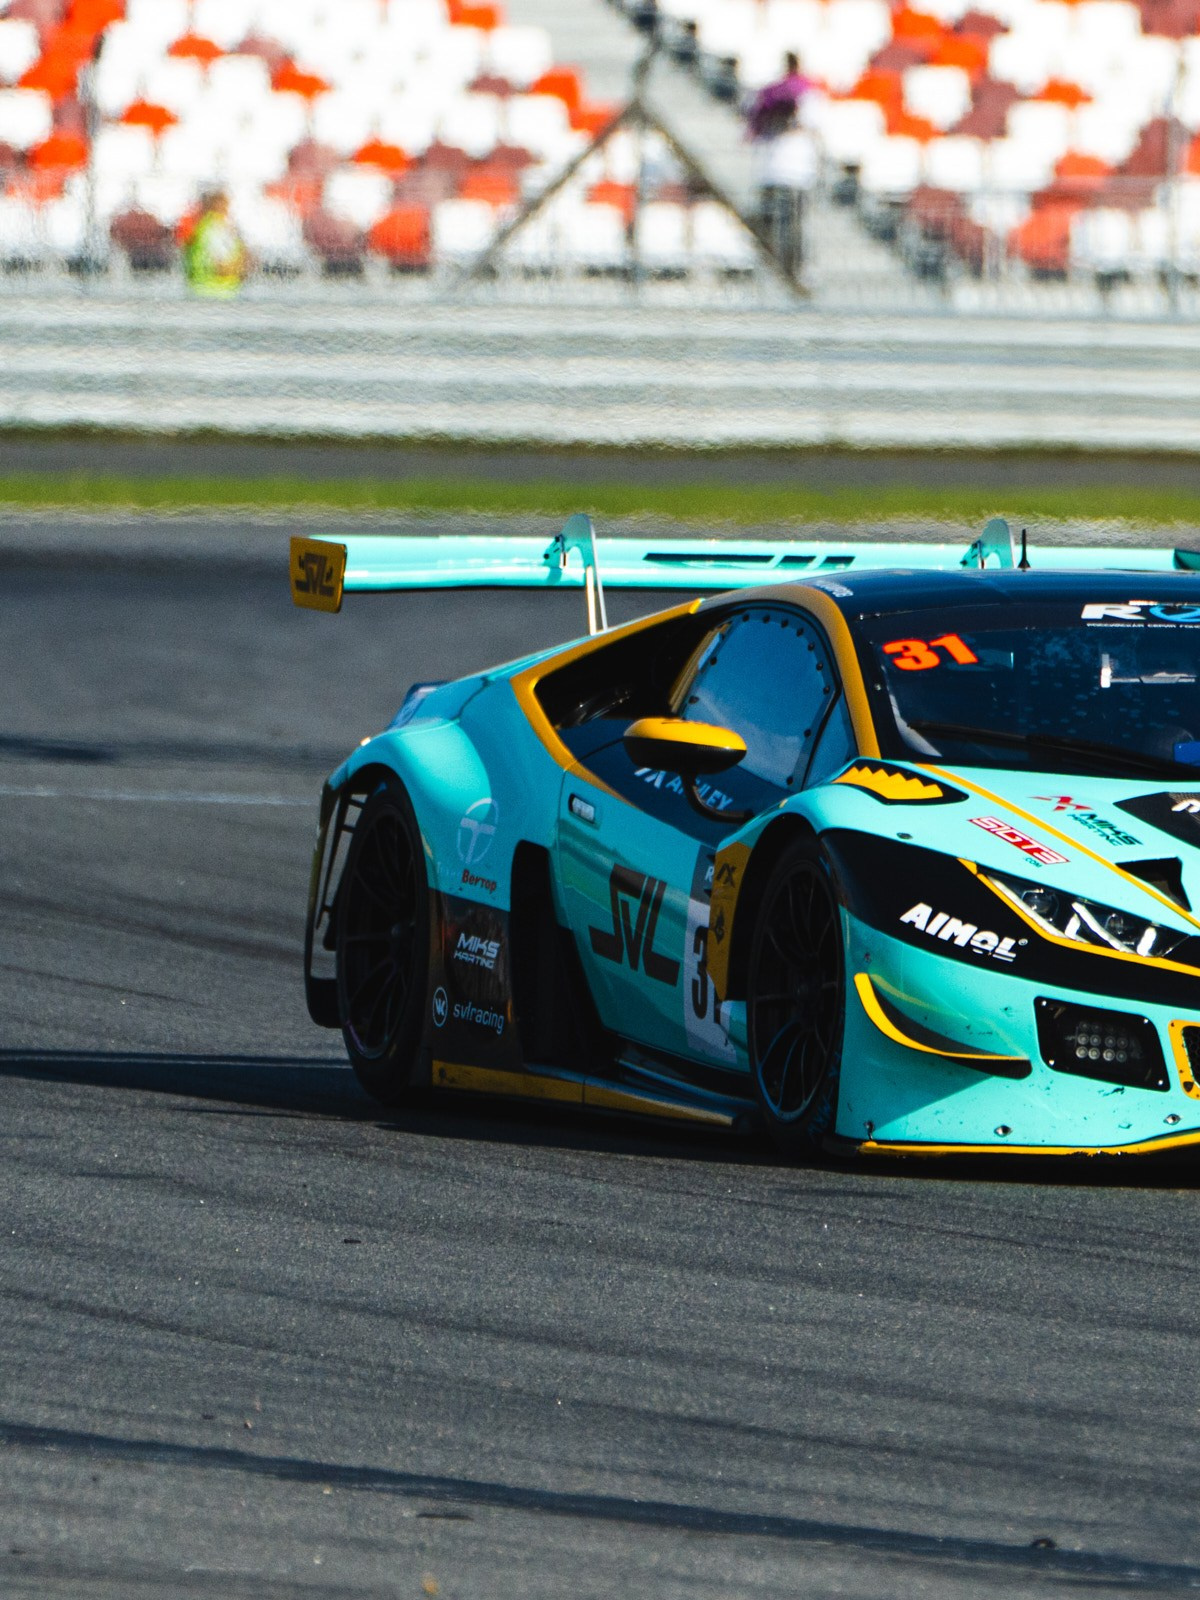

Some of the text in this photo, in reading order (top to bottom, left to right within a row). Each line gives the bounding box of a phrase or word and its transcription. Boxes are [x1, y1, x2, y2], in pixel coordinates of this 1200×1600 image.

[882, 633, 979, 671] 31
[588, 863, 680, 987] SVL
[900, 902, 1017, 962] AIMOL
[457, 932, 501, 959] MIKS
[453, 1001, 505, 1035] svlracing
